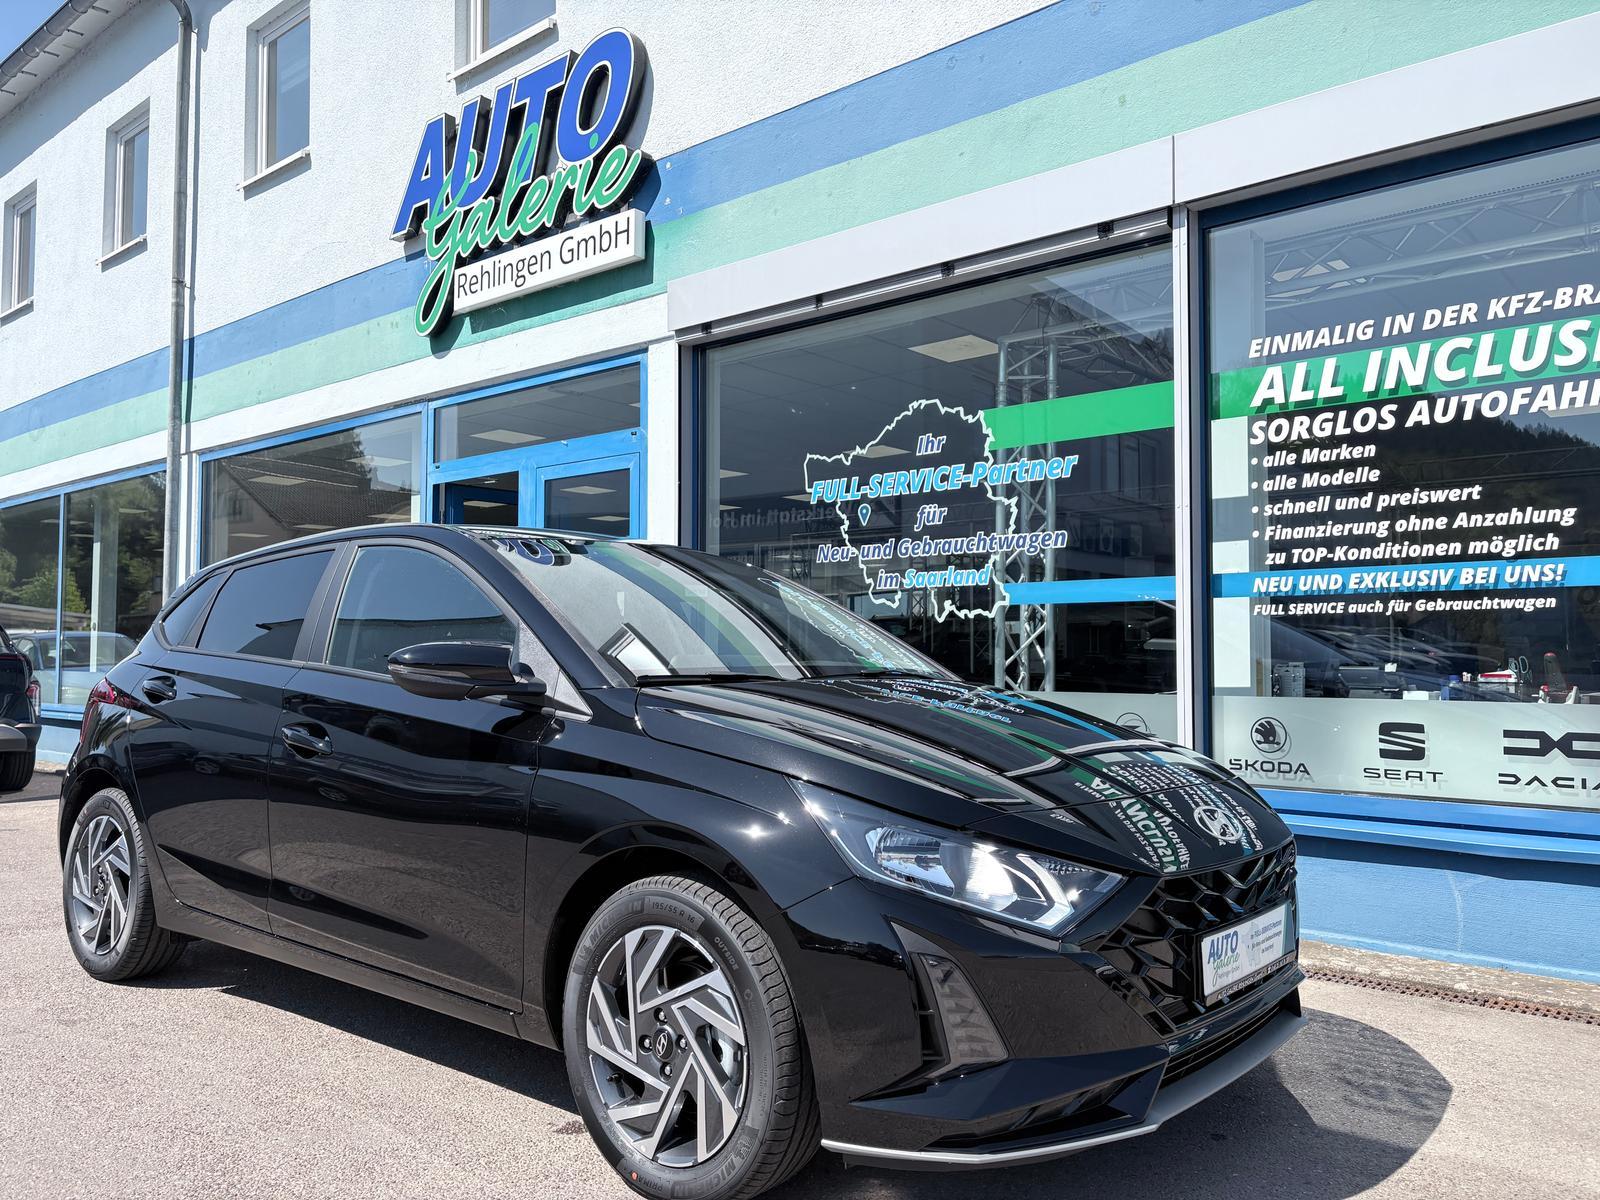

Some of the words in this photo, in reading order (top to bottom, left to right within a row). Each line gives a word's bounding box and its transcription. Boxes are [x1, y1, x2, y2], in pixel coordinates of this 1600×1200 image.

[391, 27, 635, 239] AUTO
[415, 122, 643, 336] Galerie
[457, 249, 551, 299] Rehlingen
[559, 216, 630, 265] GmbH
[1248, 319, 1375, 359] EINMALIG
[1382, 312, 1415, 337] IN
[1422, 302, 1478, 331] DER
[1249, 356, 1345, 408] ALL
[1249, 403, 1399, 445] SORGLOS
[916, 433, 947, 456] Ihr
[1263, 452, 1297, 468] alle
[1301, 444, 1376, 464] Marken
[810, 455, 1079, 505] FULL-SERVICE-Partner
[1263, 476, 1297, 492] alle
[1301, 466, 1381, 489] Modelle
[914, 504, 948, 532] für
[1263, 496, 1331, 518] schnell
[1335, 489, 1374, 512] und
[1377, 484, 1483, 512] preiswert
[1264, 518, 1391, 542] Finanzierung
[1394, 511, 1448, 533] ohne
[1452, 505, 1578, 529] Anzahlung
[816, 544, 858, 563] Neu-
[858, 539, 895, 561] und
[896, 529, 1068, 559] Gebrauchtwagen
[1265, 548, 1286, 565] zu
[1291, 539, 1462, 564] TOP-Konditionen
[1468, 532, 1560, 558] möglich
[876, 568, 901, 590] im
[902, 564, 994, 589] Saarland
[1253, 575, 1294, 594] NEU
[1298, 573, 1343, 592] UND
[1348, 568, 1456, 590] EXKLUSIV
[1459, 566, 1497, 586] BEI
[1503, 563, 1565, 583] UNS!
[1253, 603, 1286, 617] FULL
[1288, 601, 1346, 615] SERVICE
[1347, 601, 1384, 615] auch
[1387, 599, 1413, 616] für
[1414, 595, 1557, 613] Gebrauchtwagen
[1363, 767, 1444, 783] SEAT
[1498, 772, 1600, 791] DACI
[651, 901, 678, 914] 195/55
[687, 914, 696, 924] 16
[714, 936, 740, 972] OUTSIDE
[1207, 930, 1239, 964] AUTO
